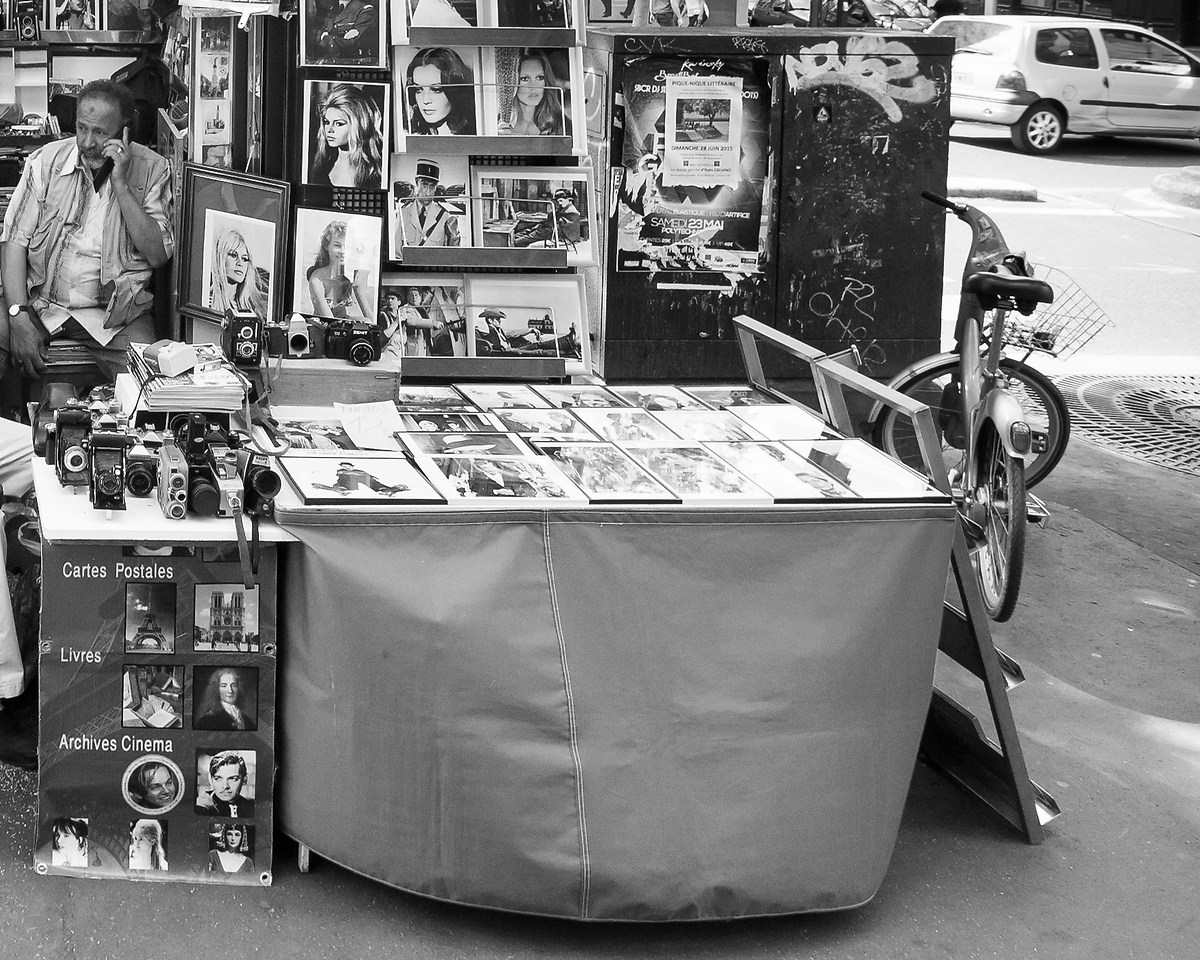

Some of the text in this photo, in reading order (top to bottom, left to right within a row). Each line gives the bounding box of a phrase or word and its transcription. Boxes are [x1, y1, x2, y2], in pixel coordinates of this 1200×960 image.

[651, 217, 724, 230] SAMEDI 23 MAI
[63, 562, 173, 579] Cartes Postales
[61, 647, 101, 663] Livres
[59, 734, 173, 753] Archives Cinema
